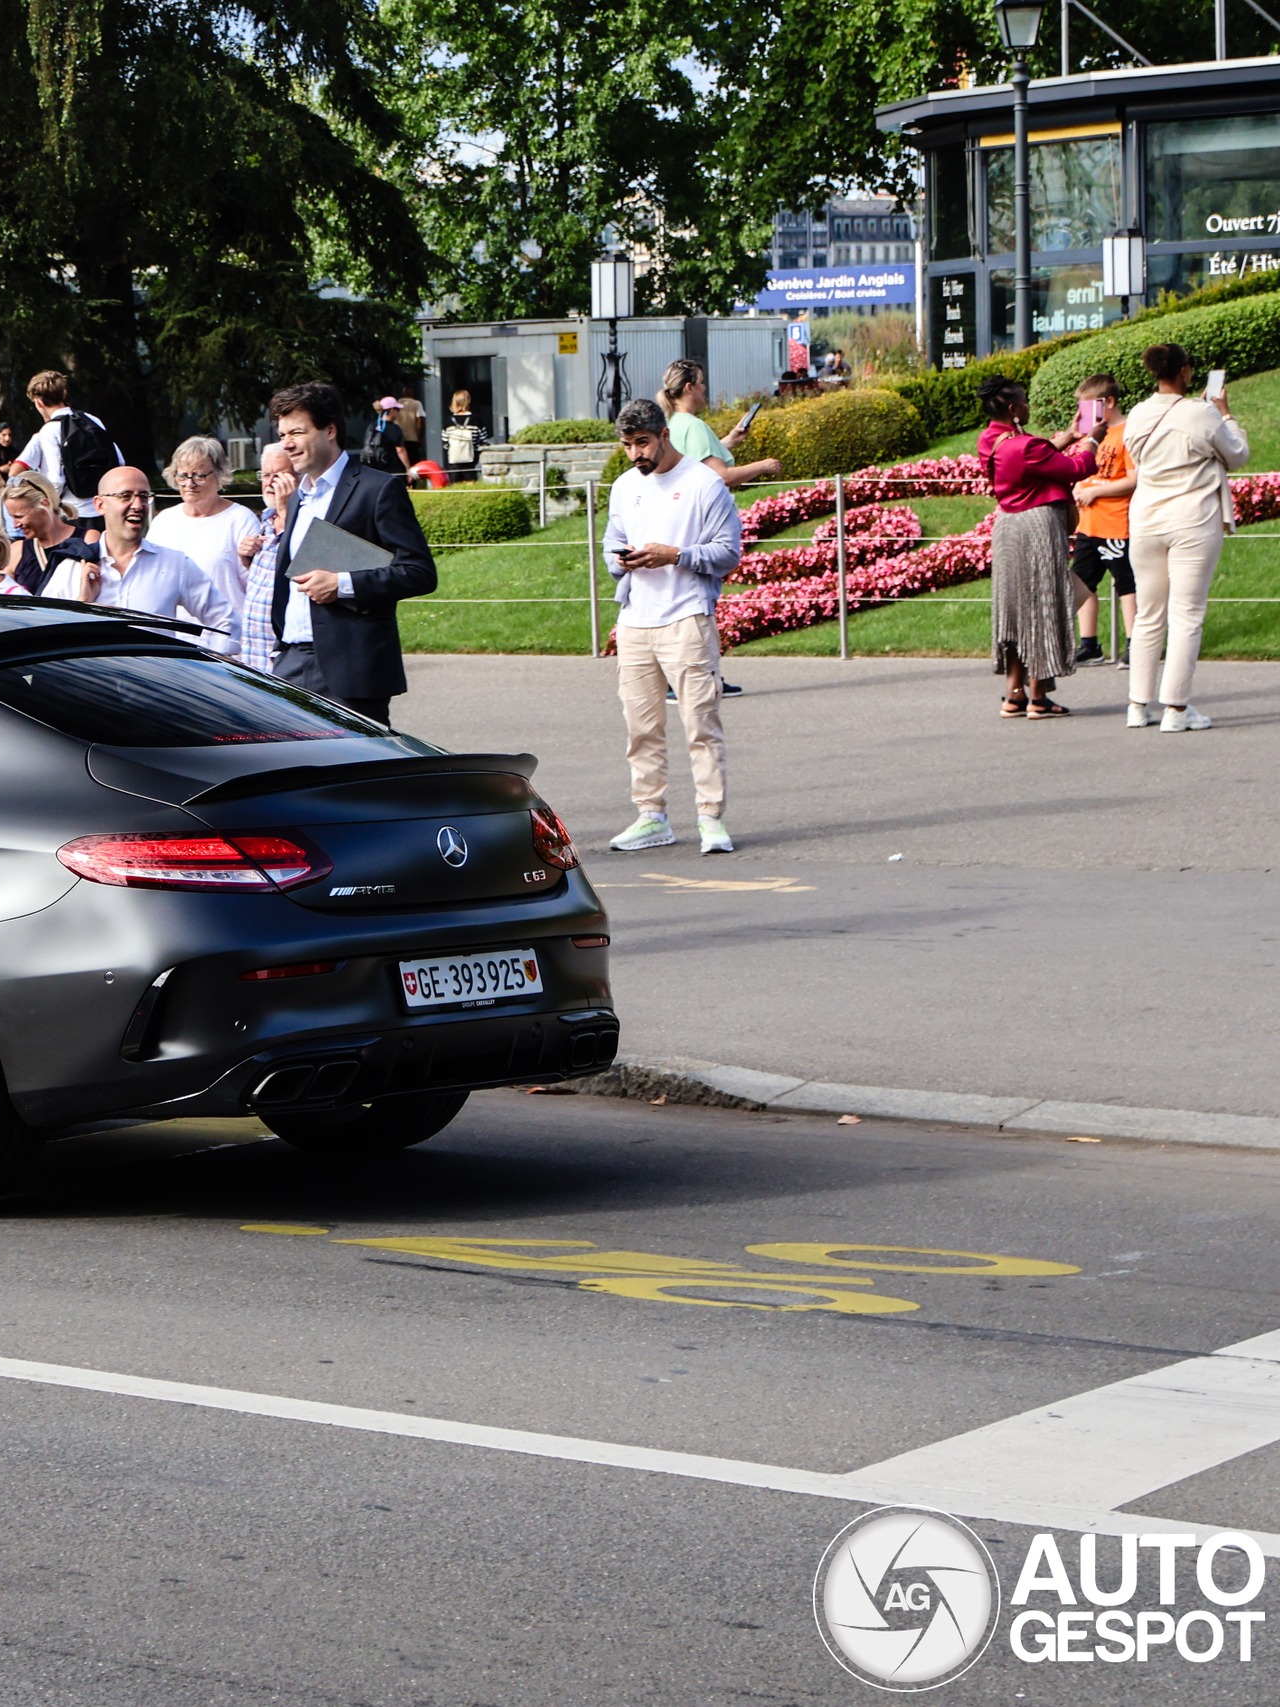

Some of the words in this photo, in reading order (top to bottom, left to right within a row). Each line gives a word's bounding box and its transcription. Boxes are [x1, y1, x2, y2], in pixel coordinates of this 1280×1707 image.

[1206, 213, 1264, 233] Ouvert
[1209, 251, 1237, 275] Été
[767, 276, 814, 291] Genève
[816, 274, 856, 289] Jardin
[858, 272, 905, 288] Anglais
[785, 290, 827, 301] Croisières
[834, 289, 855, 299] Boat
[856, 287, 887, 298] cruises
[532, 869, 547, 881] 63
